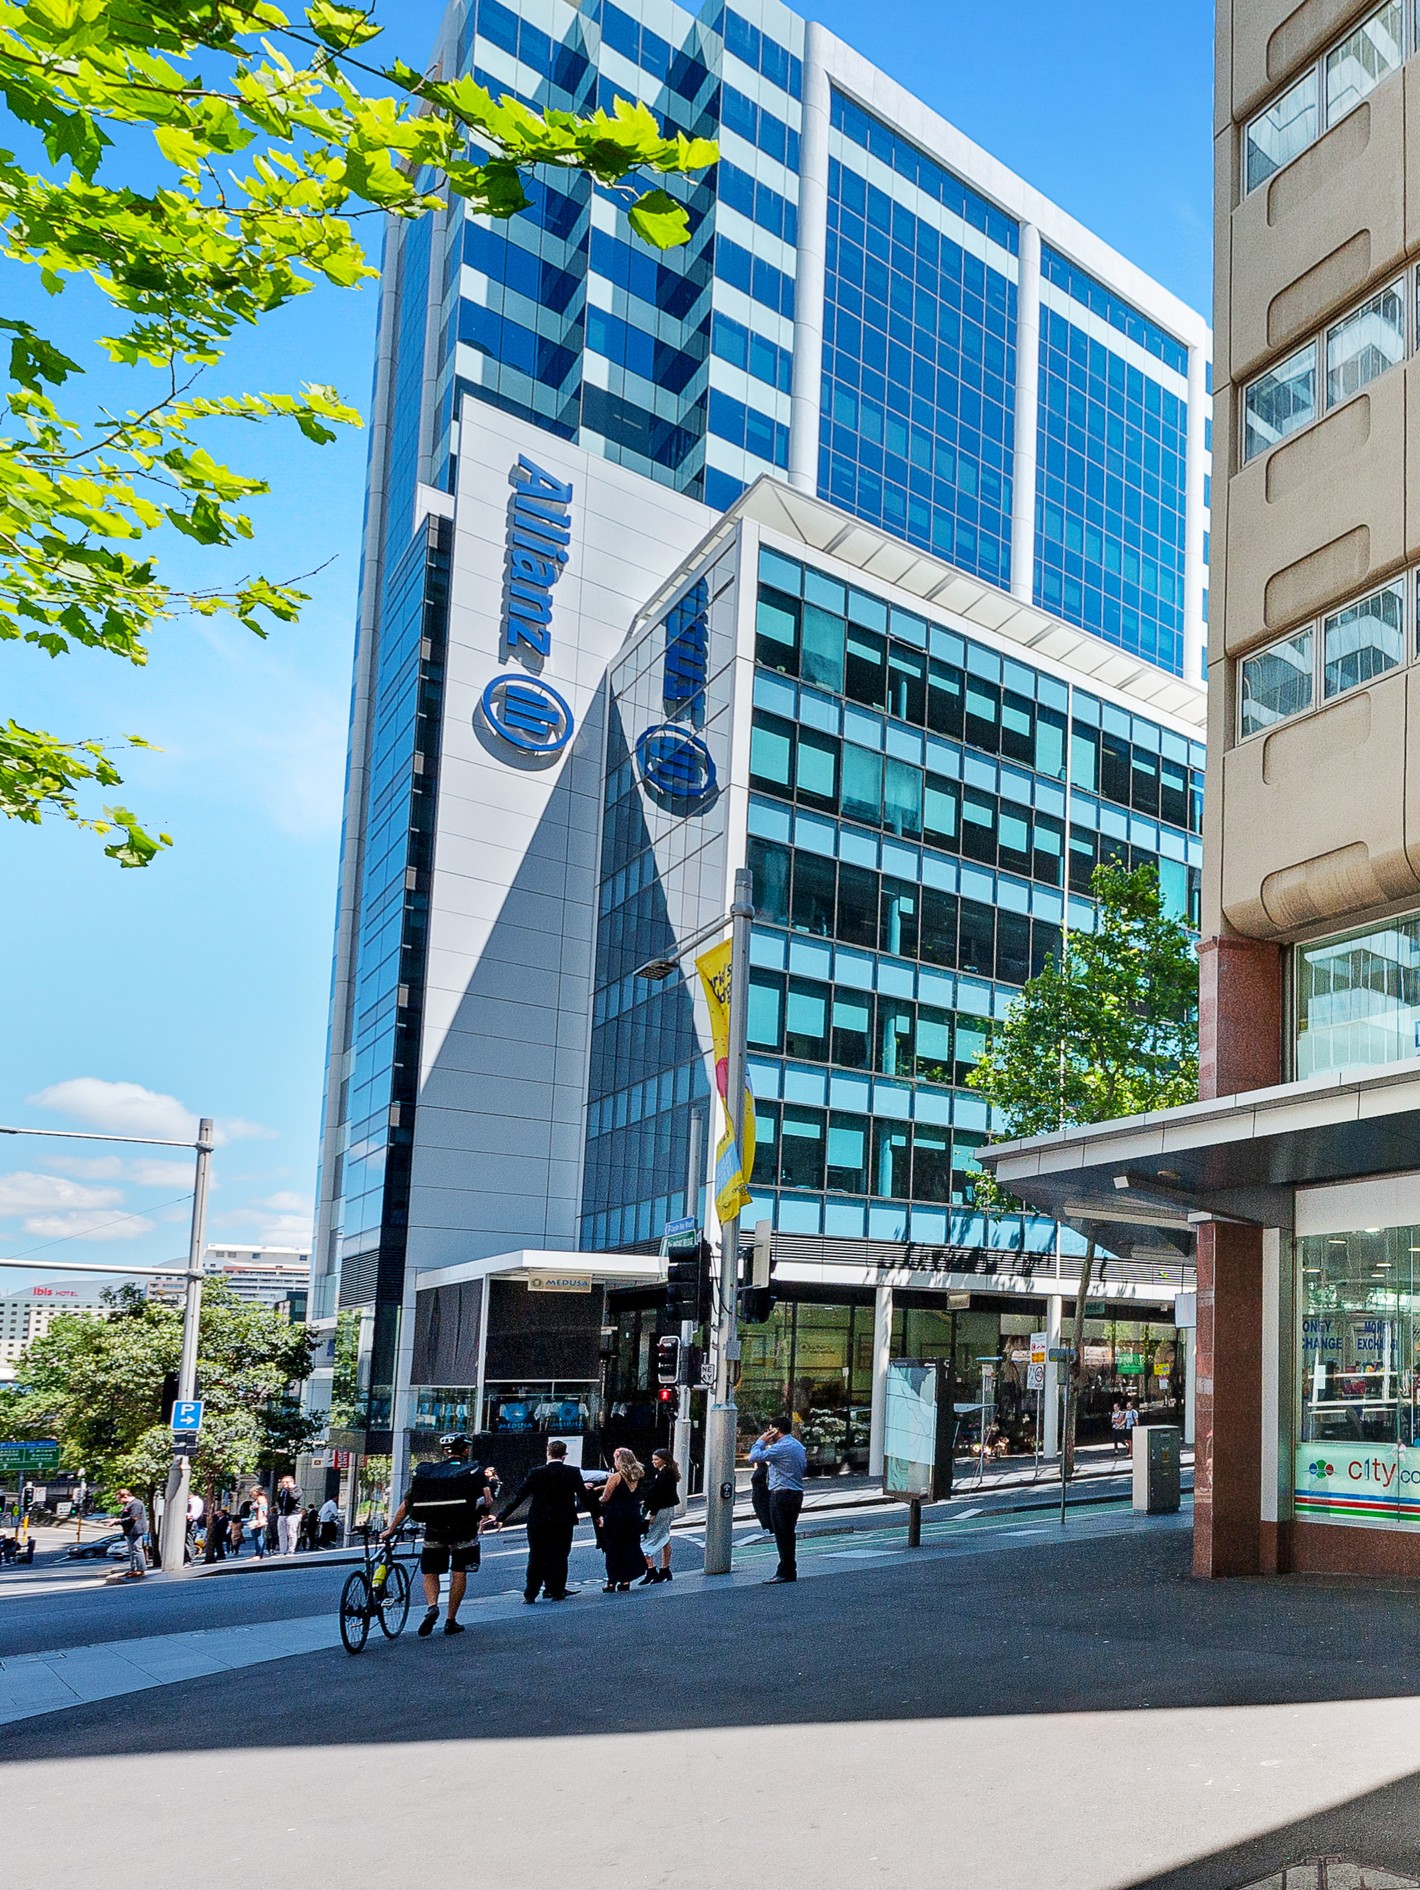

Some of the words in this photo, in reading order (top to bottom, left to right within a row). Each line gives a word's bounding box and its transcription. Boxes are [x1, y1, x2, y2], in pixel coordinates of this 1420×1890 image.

[506, 453, 573, 656] Allianz
[546, 1279, 588, 1287] MEDUSA
[1302, 1320, 1332, 1333] ONEY
[1302, 1337, 1343, 1350] CHANGE
[181, 1404, 195, 1415] P
